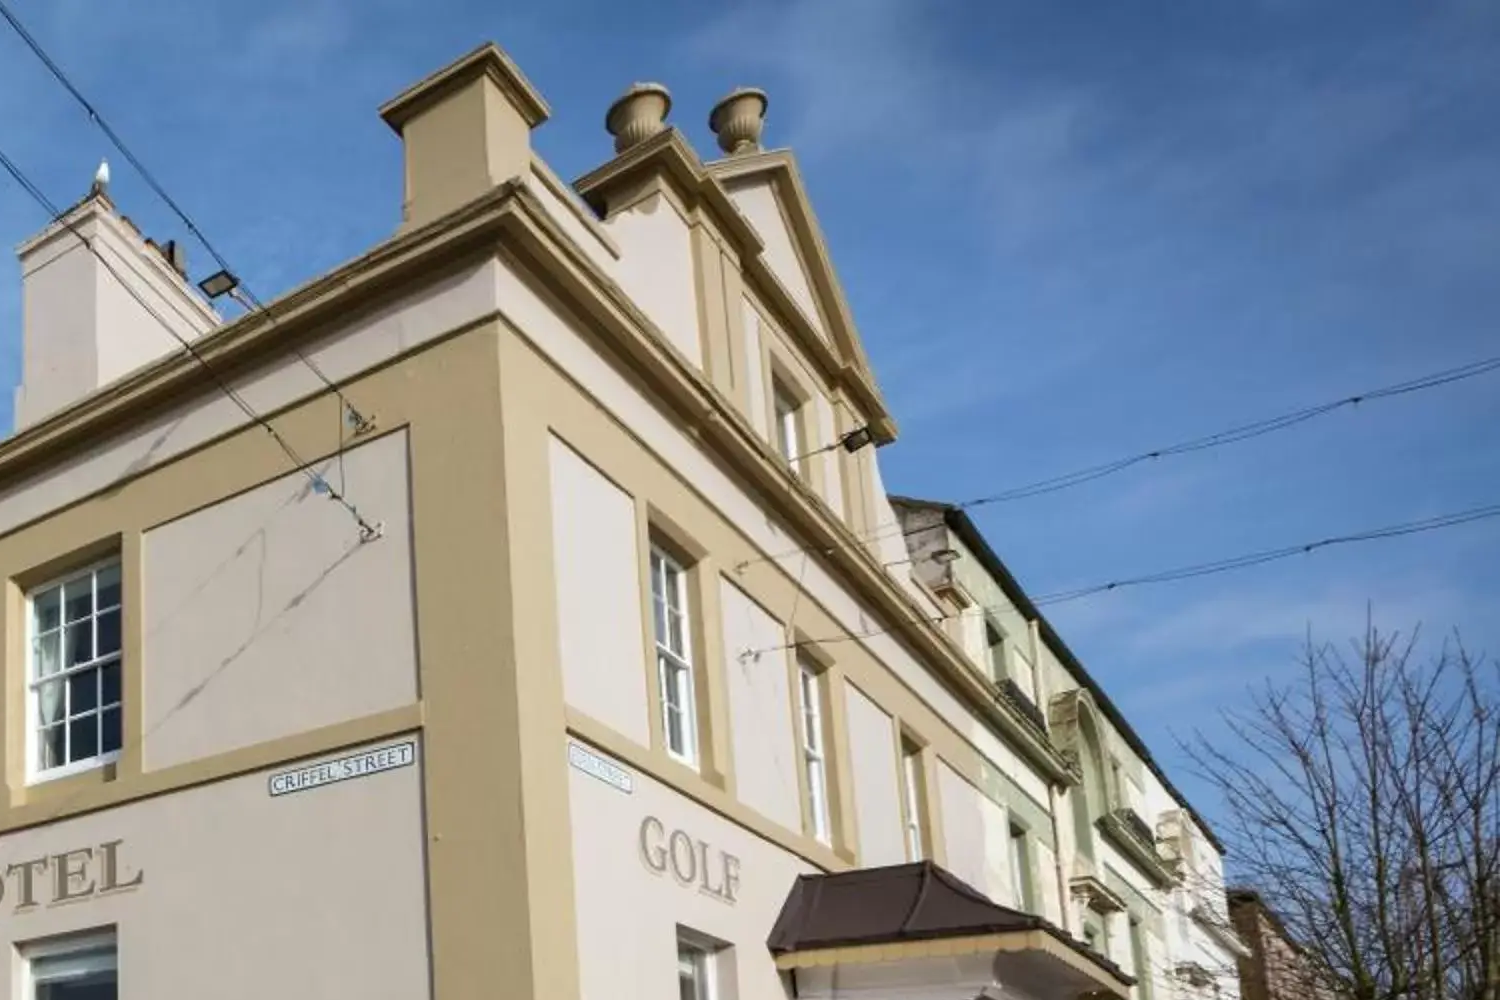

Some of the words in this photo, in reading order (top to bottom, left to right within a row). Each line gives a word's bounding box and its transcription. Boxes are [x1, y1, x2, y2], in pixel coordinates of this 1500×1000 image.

[273, 765, 337, 791] CRIFFEL
[343, 747, 409, 776] STREET
[639, 815, 740, 906] GOLF
